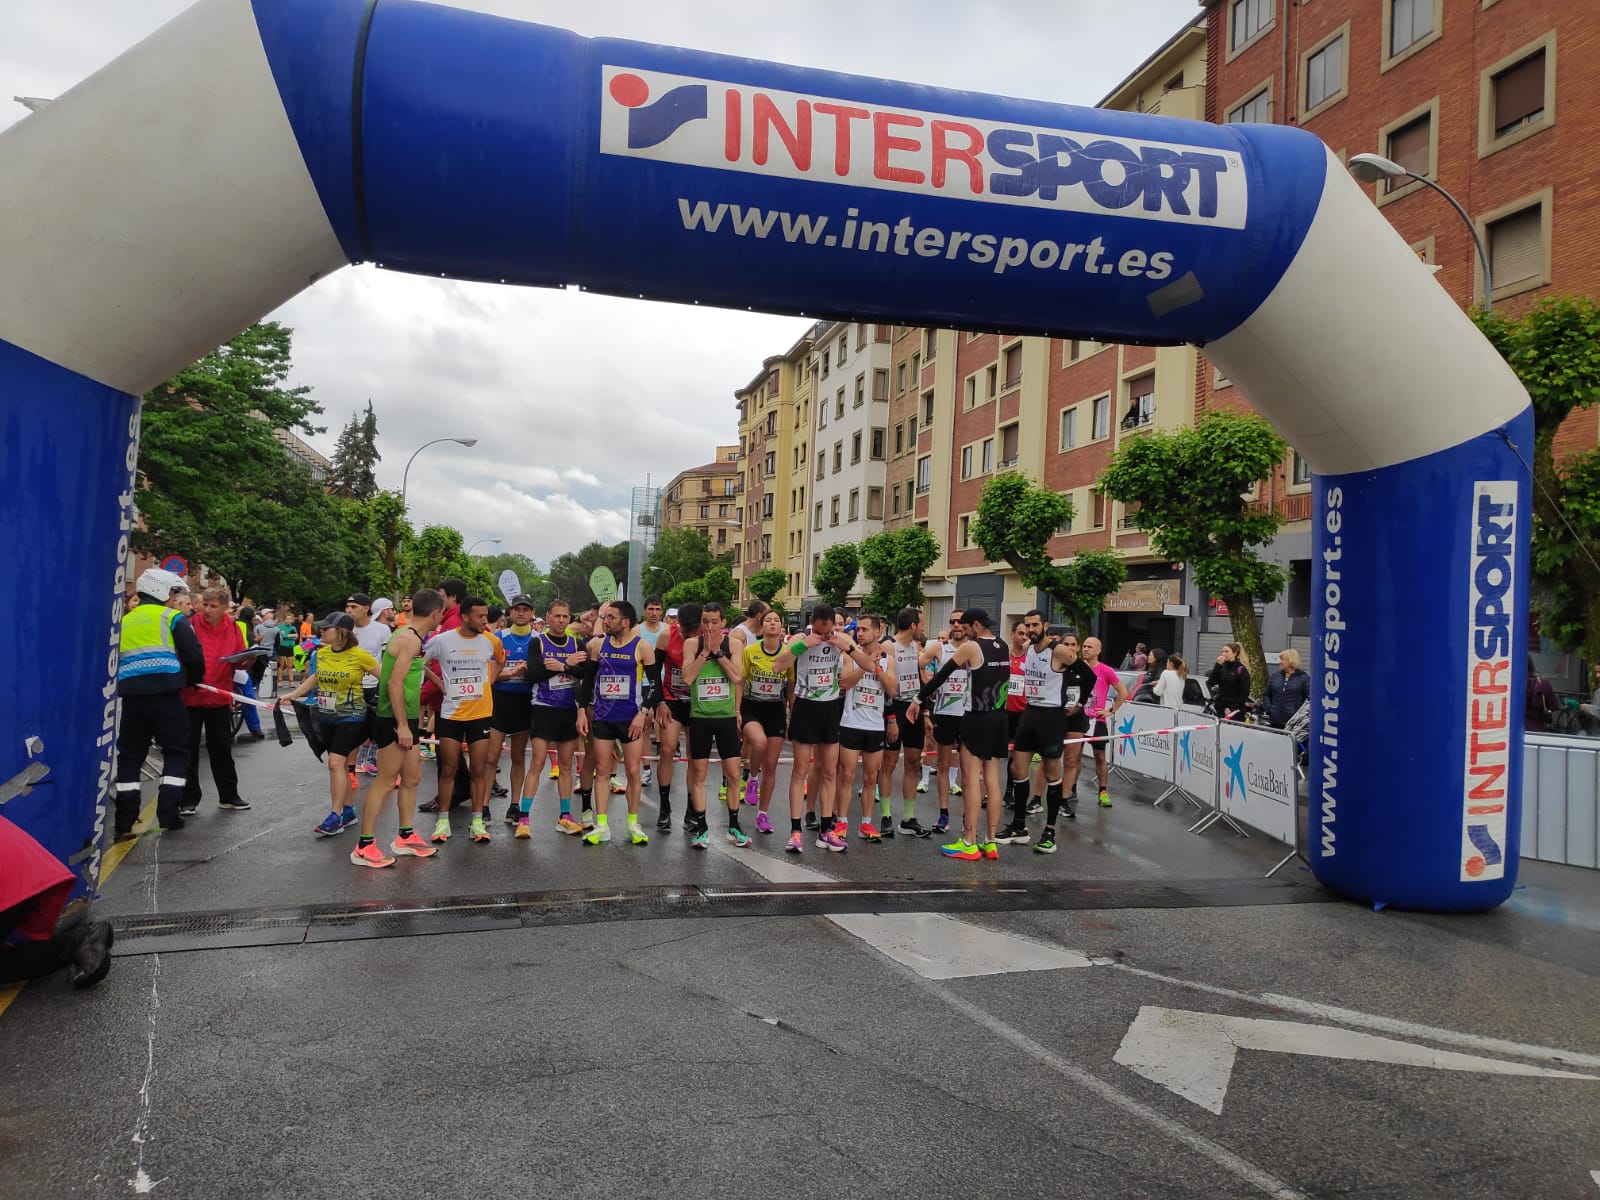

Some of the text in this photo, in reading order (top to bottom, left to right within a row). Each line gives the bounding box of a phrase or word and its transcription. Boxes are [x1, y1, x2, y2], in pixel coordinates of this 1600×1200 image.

[724, 88, 1227, 218] INTERSPORT
[677, 197, 1174, 279] www.intersport.es
[1468, 494, 1514, 815] INTERSPORT
[1320, 486, 1346, 858] www.intersport.es
[558, 674, 572, 683] 25
[817, 675, 830, 685] 34
[459, 684, 475, 694] 30
[606, 683, 620, 693] 24
[706, 685, 721, 695] 29
[759, 684, 773, 693] 42
[906, 682, 915, 690] 31
[949, 683, 962, 692] 32
[1028, 686, 1038, 696] 33
[318, 698, 327, 708] 41
[862, 693, 876, 705] 35
[1191, 742, 1214, 769] CaixaBank
[1247, 762, 1290, 799] CaixaBank
